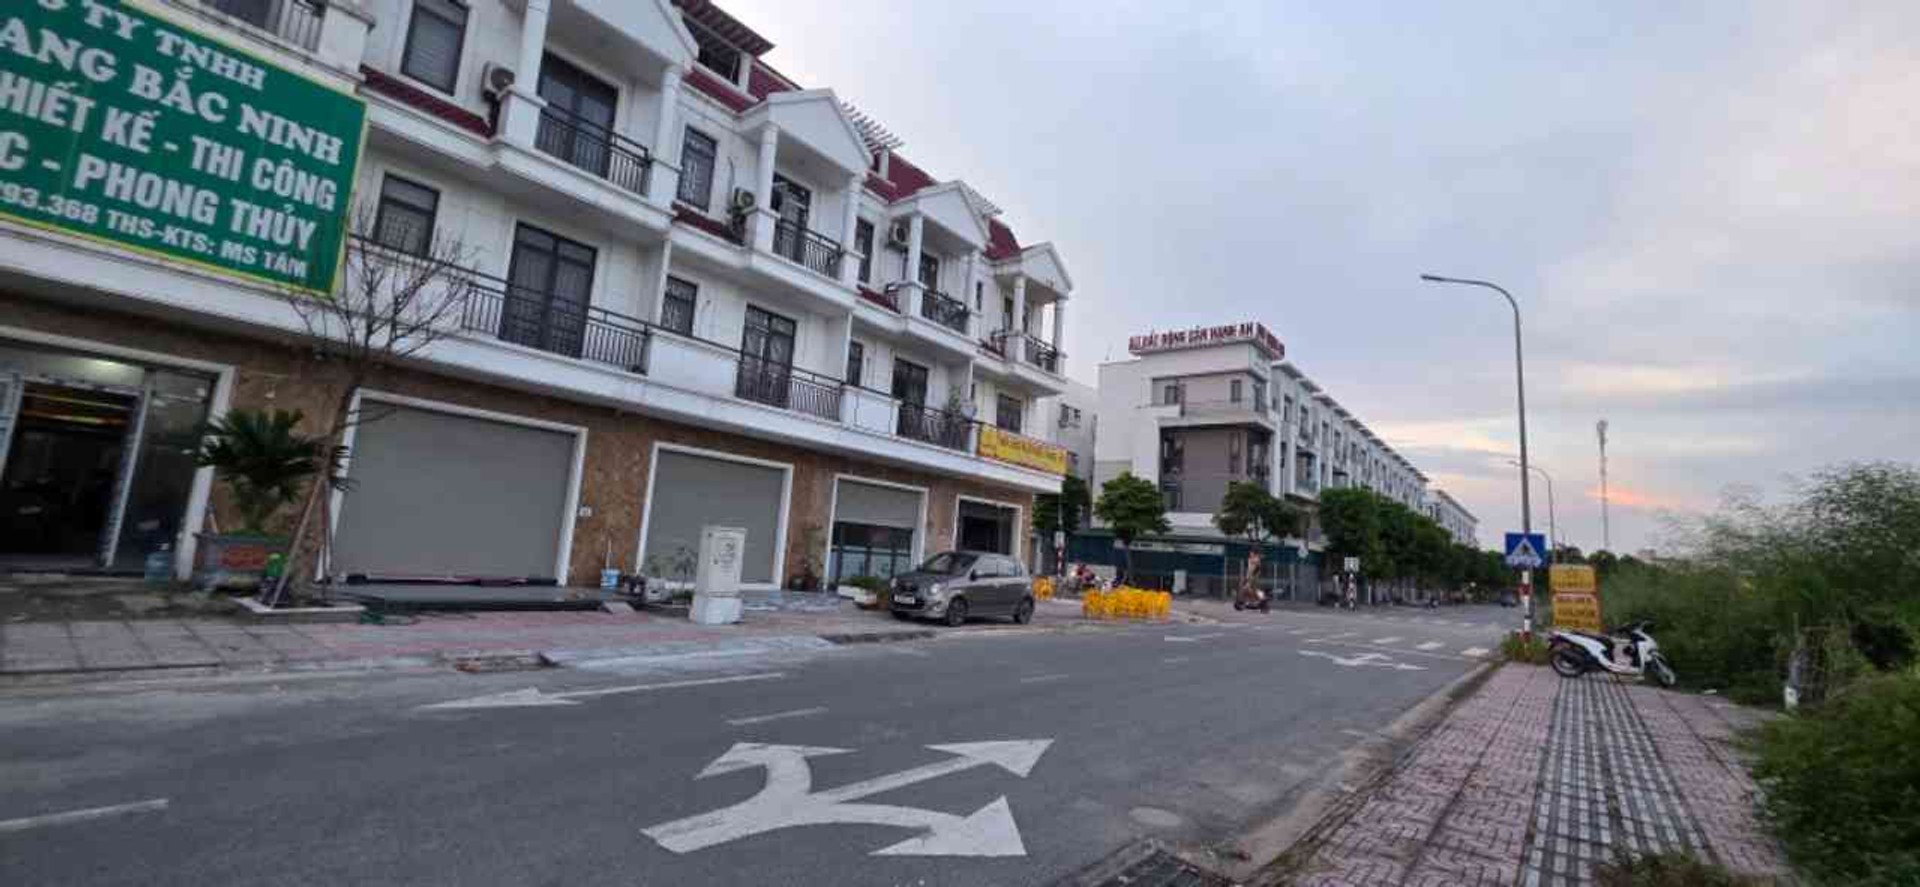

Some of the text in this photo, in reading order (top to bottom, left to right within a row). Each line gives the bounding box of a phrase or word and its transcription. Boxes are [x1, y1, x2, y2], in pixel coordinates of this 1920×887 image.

[83, 1, 267, 91] TY TNHH
[101, 106, 161, 153] KẾ
[190, 135, 244, 181] THI
[252, 157, 338, 212] CÔNG
[128, 64, 229, 123] BẮC
[236, 103, 343, 165] NINH
[73, 153, 219, 226] PHONG
[229, 199, 317, 250] THỦY
[106, 209, 215, 254] THS-KTS:
[219, 240, 257, 265] MS
